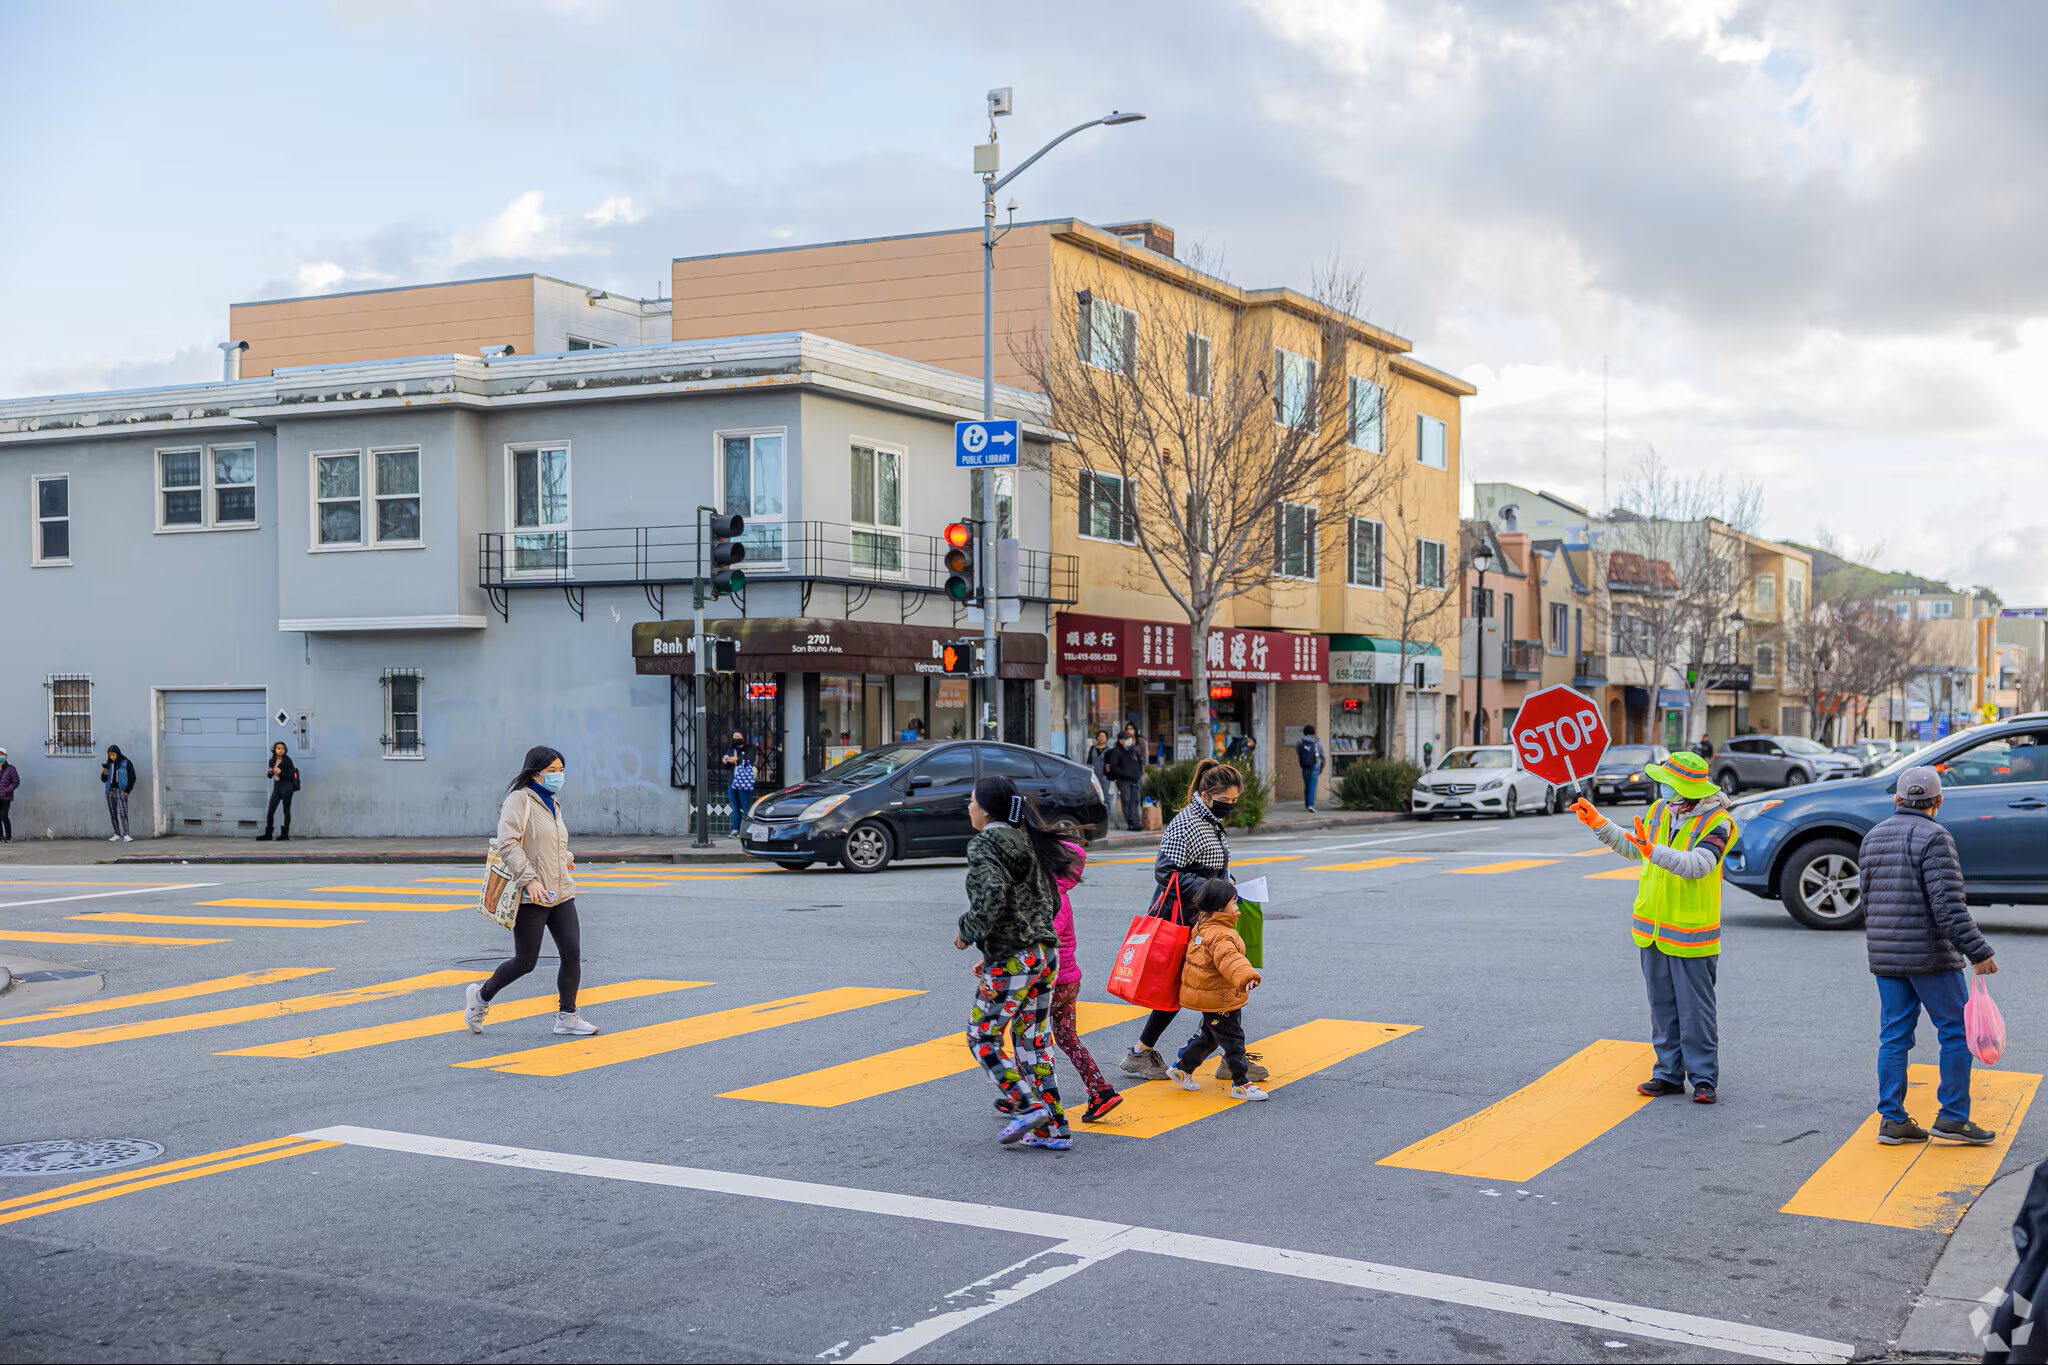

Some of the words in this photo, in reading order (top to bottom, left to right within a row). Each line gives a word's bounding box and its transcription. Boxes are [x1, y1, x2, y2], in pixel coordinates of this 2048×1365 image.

[962, 455, 983, 465] PUBLIC
[985, 453, 1010, 464] LIBRARY
[653, 636, 683, 654] Banh
[807, 634, 830, 645] 2701
[791, 644, 806, 653] San
[807, 645, 828, 653] Bruno
[829, 645, 844, 653] Ave.
[1335, 669, 1371, 680] 656-0202
[1519, 709, 1598, 764] STOP
